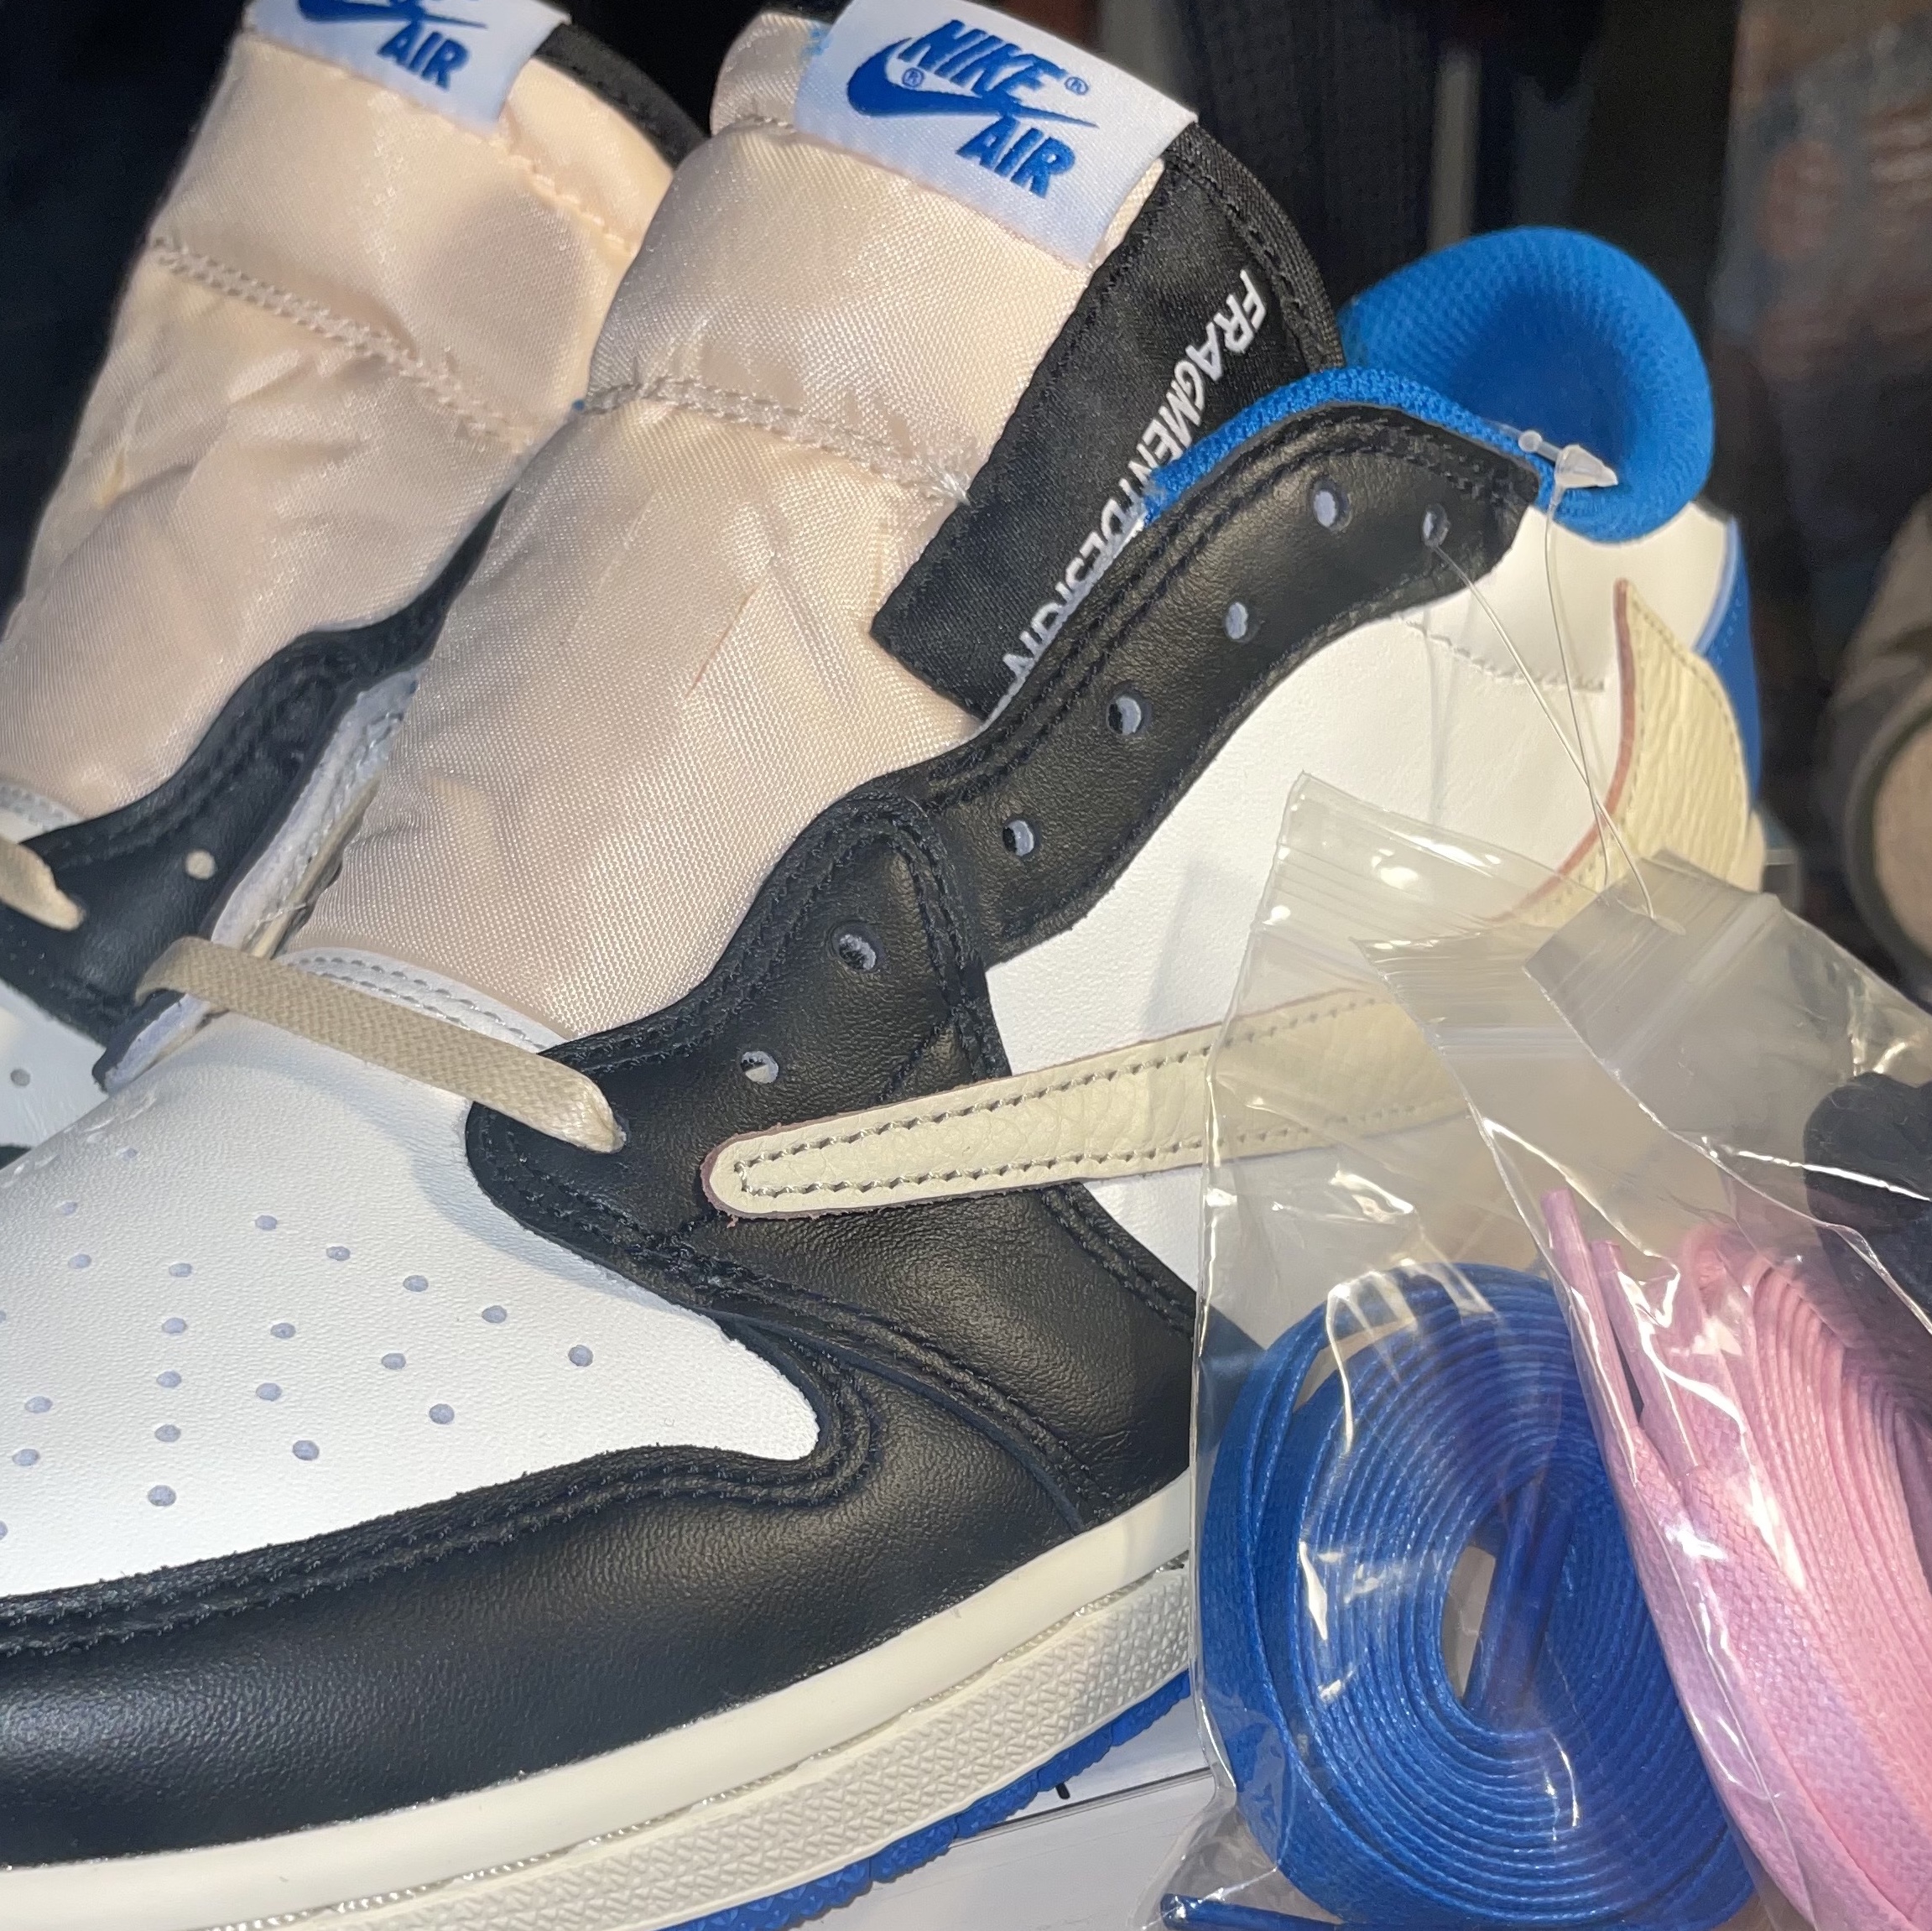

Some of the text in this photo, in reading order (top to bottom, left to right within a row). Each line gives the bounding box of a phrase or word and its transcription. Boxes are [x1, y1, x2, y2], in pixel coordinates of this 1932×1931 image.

[378, 21, 470, 92] AIR
[897, 18, 1068, 104] NIKE
[956, 116, 1076, 200] AIR
